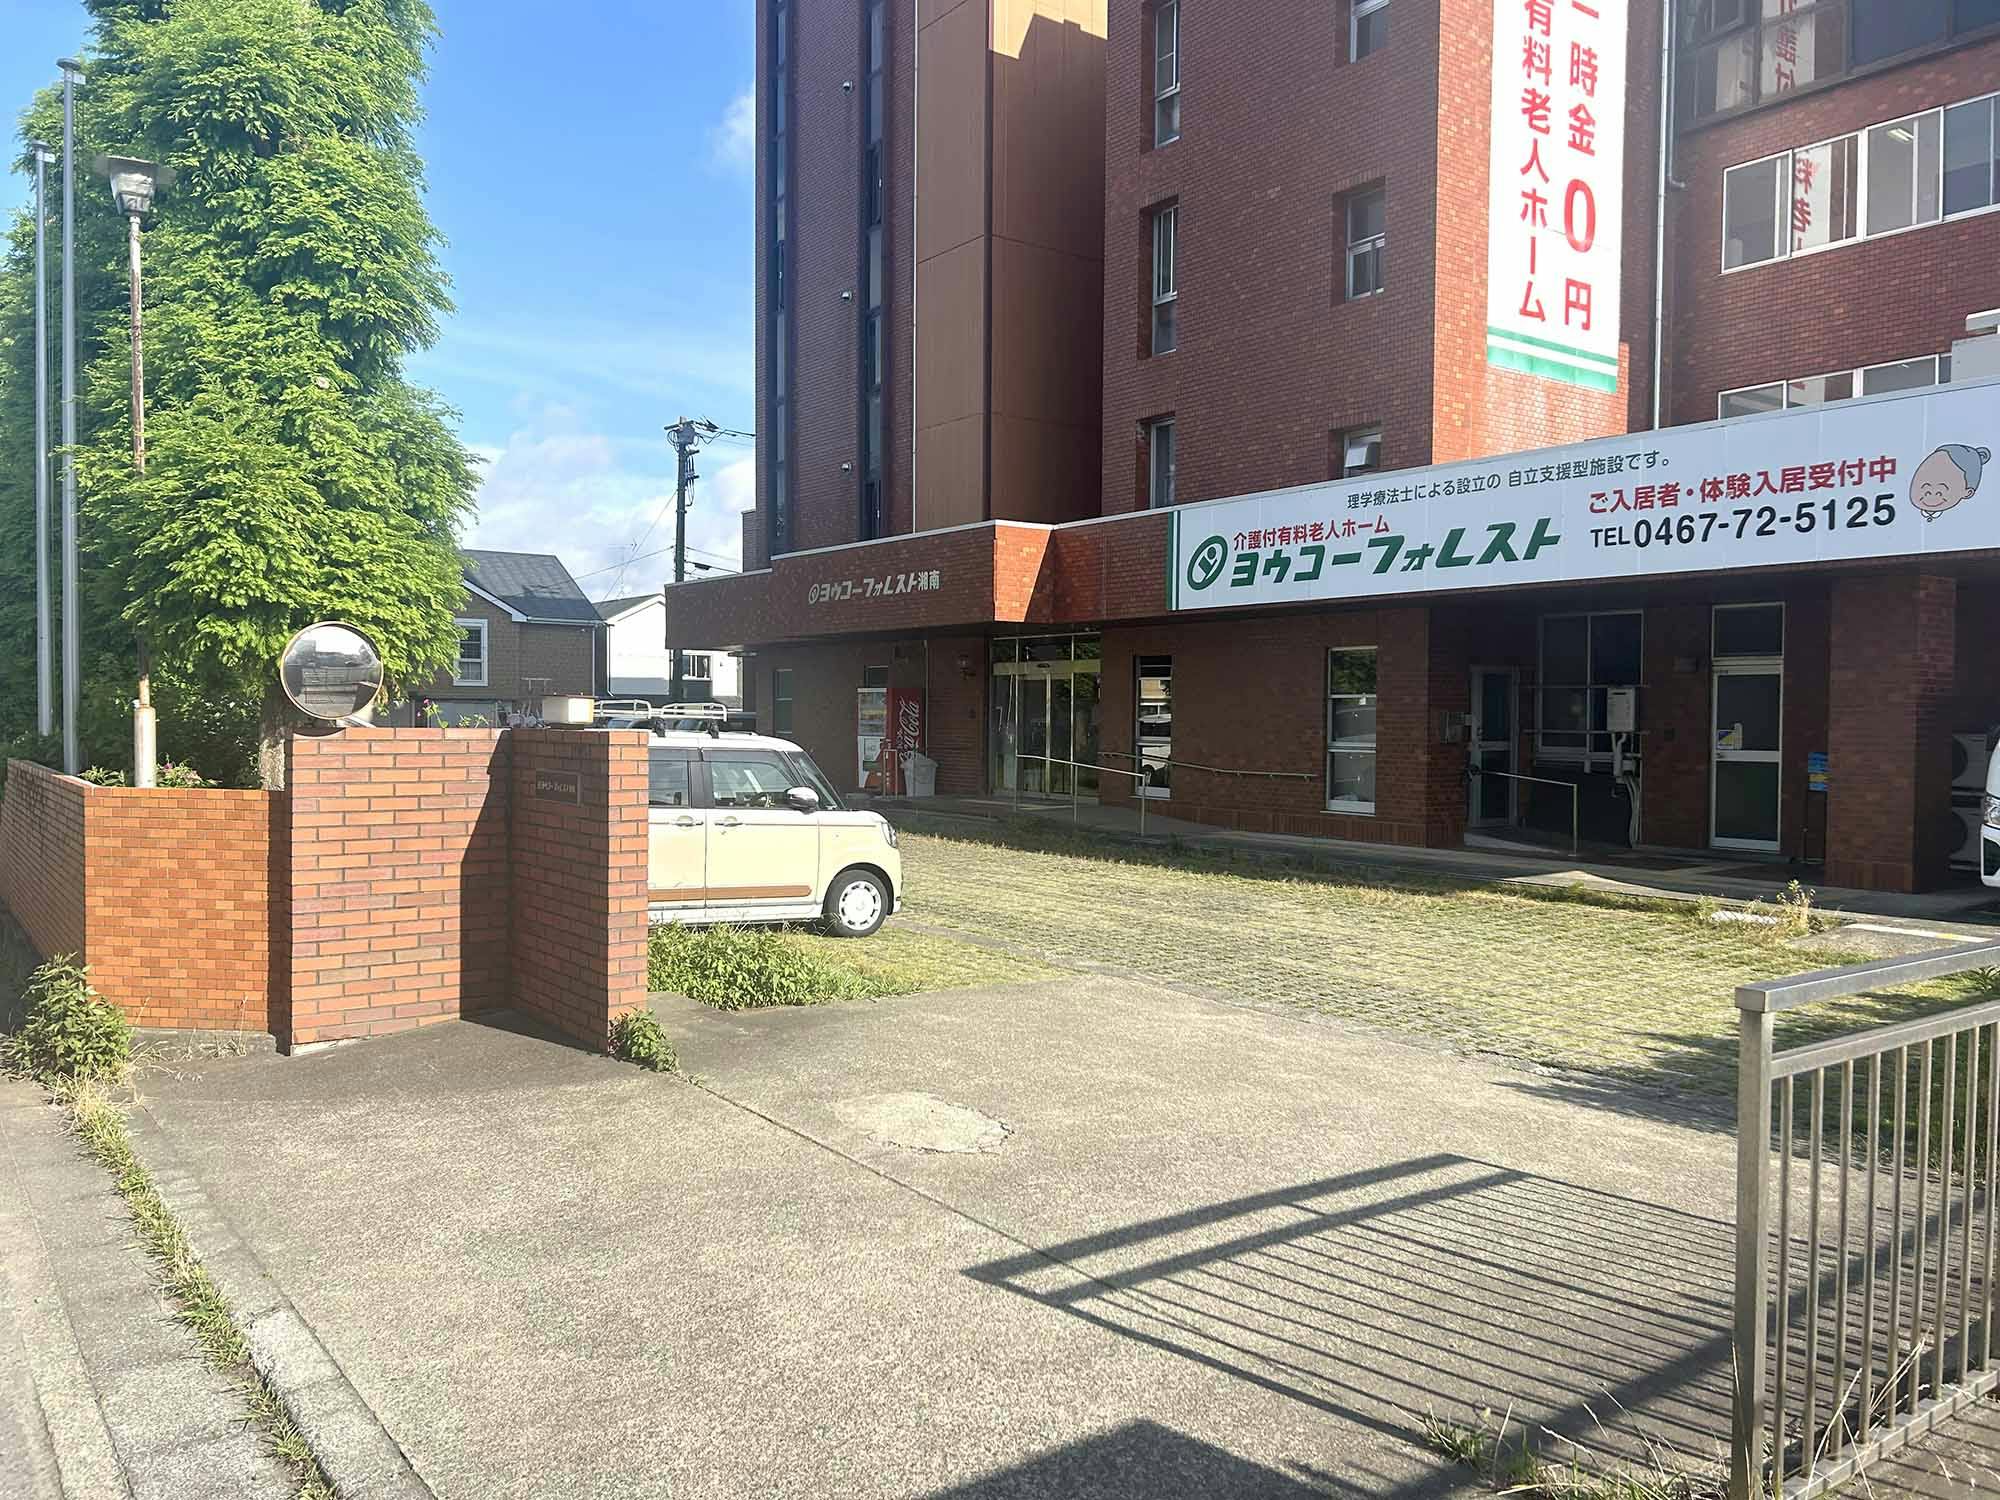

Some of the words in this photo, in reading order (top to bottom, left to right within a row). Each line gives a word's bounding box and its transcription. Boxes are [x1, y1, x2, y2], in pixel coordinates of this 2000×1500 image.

[1347, 472, 1501, 510] 理学療法士による設立の
[1508, 449, 1670, 488] 自立支援型施設です。
[1588, 455, 1897, 514] ご入居者・体験入居受付中
[1230, 517, 1561, 588] ヨウコーフォレスト
[1233, 514, 1390, 551] 介護付有料老人ホーム
